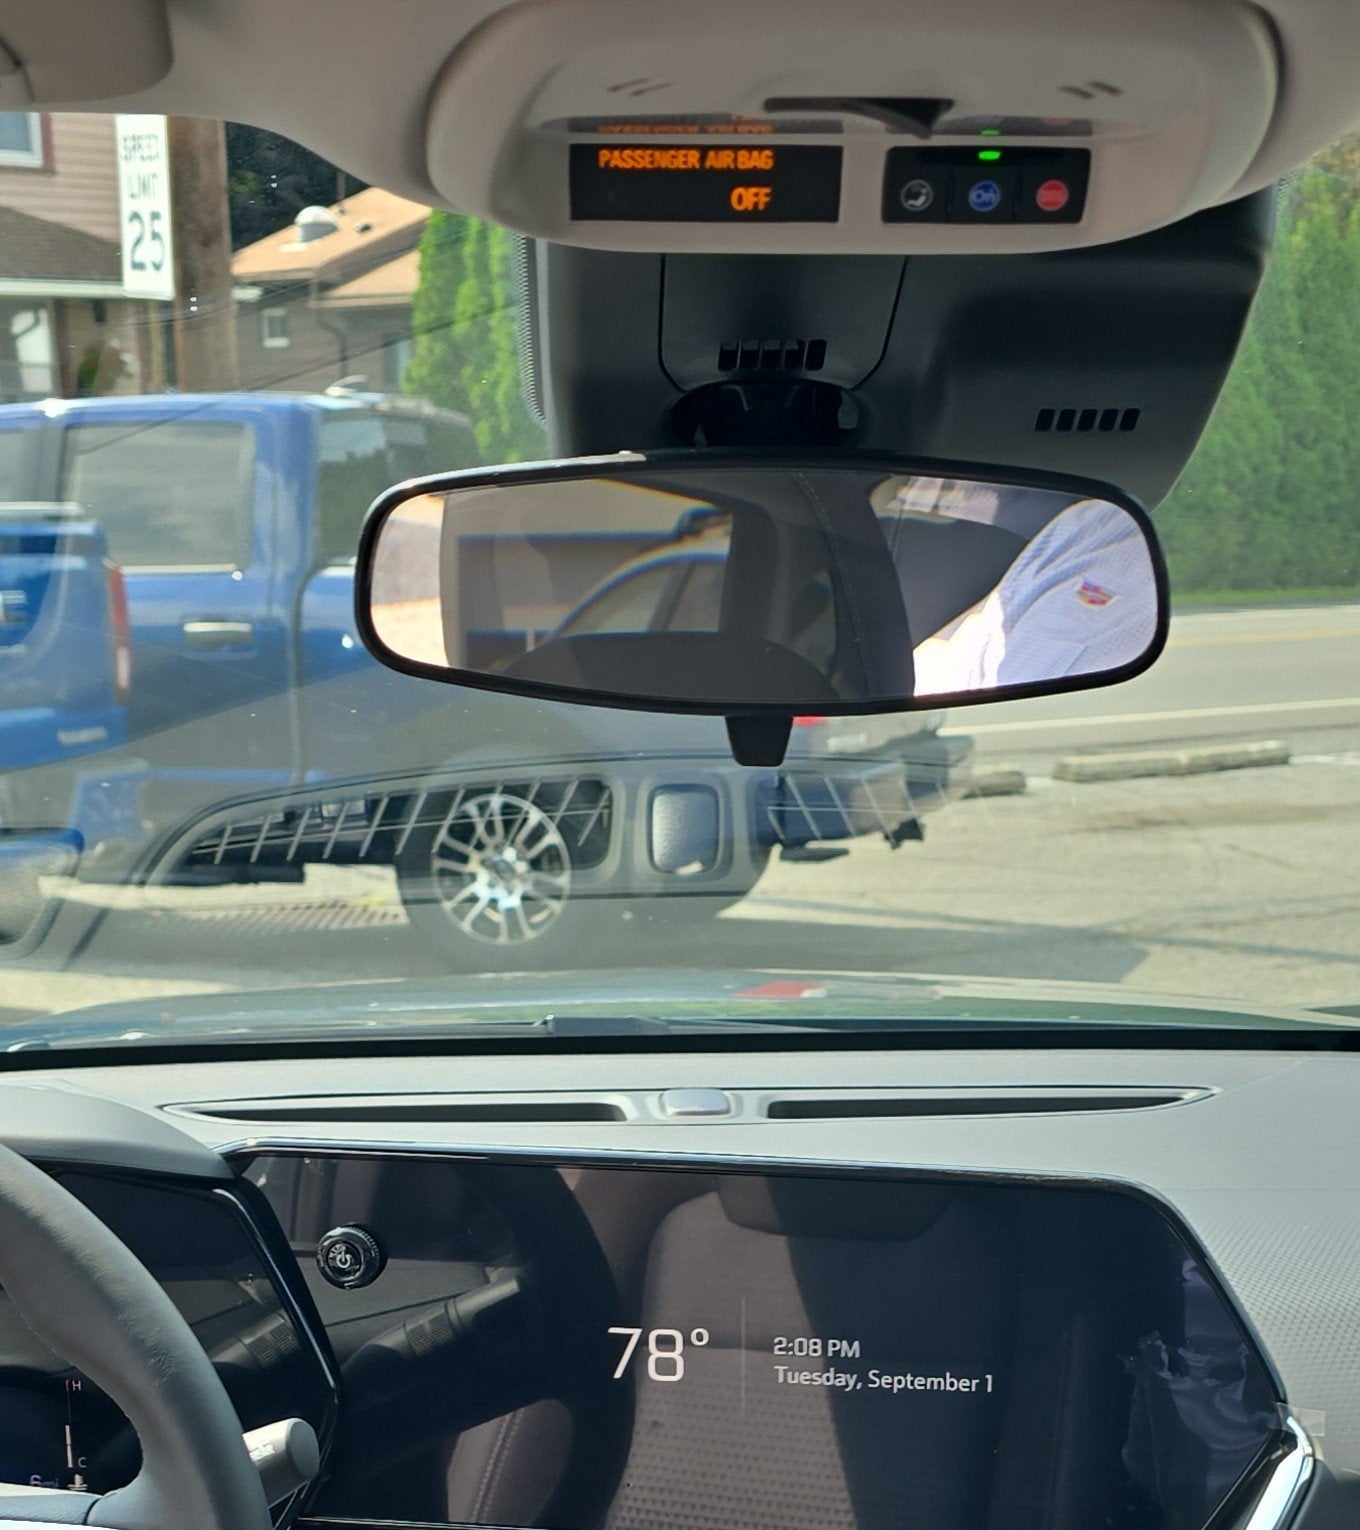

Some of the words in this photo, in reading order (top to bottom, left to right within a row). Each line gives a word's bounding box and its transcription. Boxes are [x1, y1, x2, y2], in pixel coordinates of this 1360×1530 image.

[598, 149, 701, 170] PASSENGER
[705, 149, 735, 170] AIR
[737, 149, 775, 171] BAG
[730, 186, 773, 212] OFF
[128, 210, 166, 272] 25
[606, 1326, 710, 1382] 78°
[772, 1336, 823, 1357] 2:08
[826, 1338, 861, 1359] PM
[72, 1380, 82, 1391] H
[773, 1365, 862, 1391] Tuesday,
[867, 1369, 979, 1395] September
[985, 1374, 993, 1392] 1
[77, 1457, 88, 1468] C
